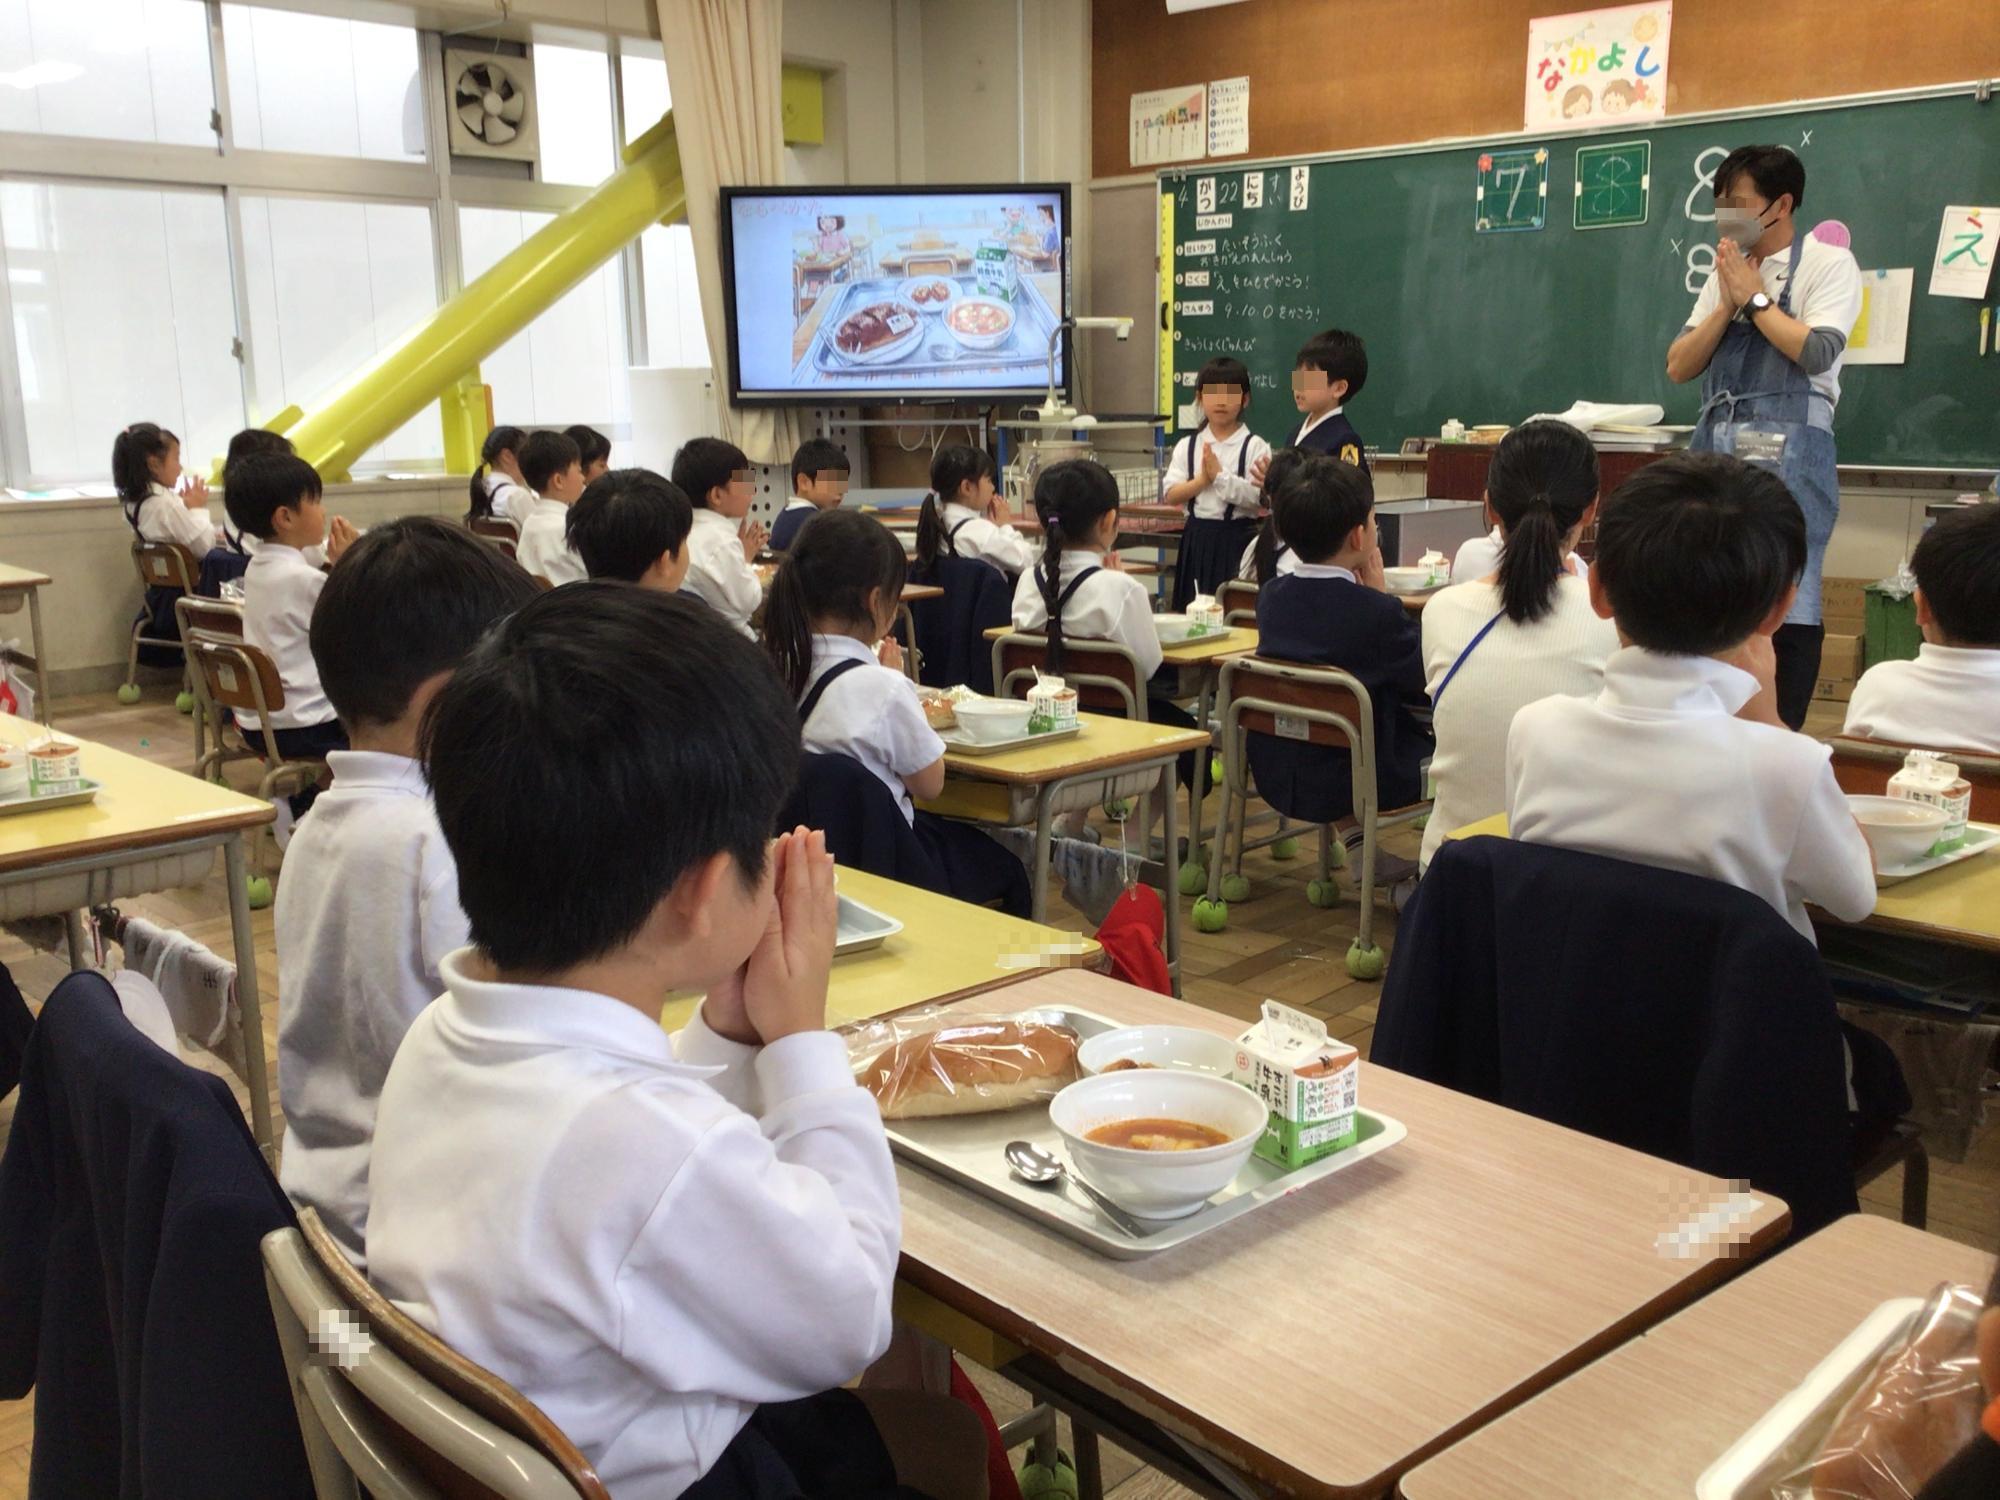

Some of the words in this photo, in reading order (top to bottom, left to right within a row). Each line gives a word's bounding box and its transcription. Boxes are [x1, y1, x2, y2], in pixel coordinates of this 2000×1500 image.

[1537, 42, 1660, 92] なかよし
[1178, 184, 1189, 209] 4
[1199, 179, 1212, 210] がつ
[1219, 180, 1238, 205] 22
[1246, 174, 1259, 206] にち
[1268, 172, 1281, 206] すい
[1293, 168, 1305, 209] ようび
[1495, 164, 1529, 222] 7
[1197, 215, 1231, 228] じかんわり
[1942, 216, 1988, 266] え
[1187, 275, 1207, 285] こくご
[1260, 1064, 1272, 1103] 牛乳
